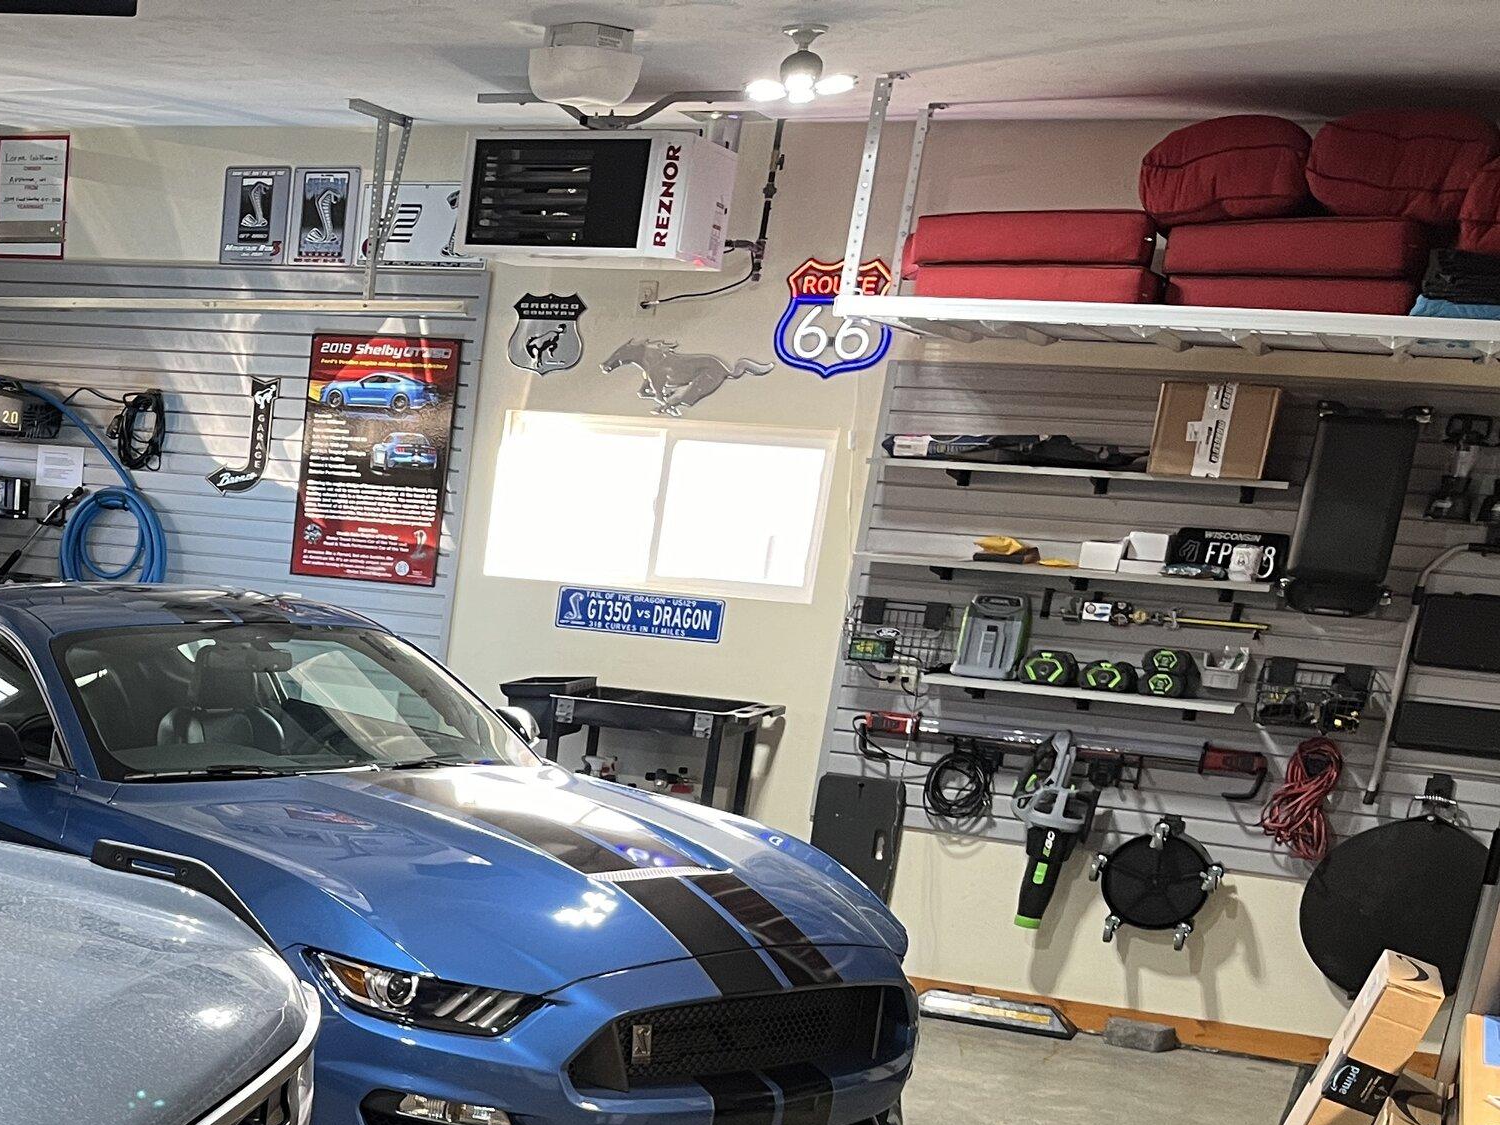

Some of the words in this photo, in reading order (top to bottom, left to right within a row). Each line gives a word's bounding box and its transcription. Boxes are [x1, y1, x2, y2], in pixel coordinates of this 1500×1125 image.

[652, 145, 682, 247] REZNOR
[520, 302, 579, 310] BRONCO
[793, 305, 870, 360] 66
[320, 342, 352, 354] 2019
[355, 343, 403, 359] Shelby
[254, 414, 265, 468] GARAGE
[217, 472, 257, 487] Bronco
[1205, 530, 1262, 543] WISCONSIN
[586, 591, 602, 600] TAIL
[617, 594, 631, 602] THE
[634, 595, 666, 605] DRAGON
[587, 599, 632, 623] GT350
[652, 605, 712, 631] DRAGON
[605, 622, 637, 632] CURVES
[660, 628, 686, 637] MILES
[1042, 830, 1055, 857] EGO
[1339, 1065, 1360, 1095] prime
